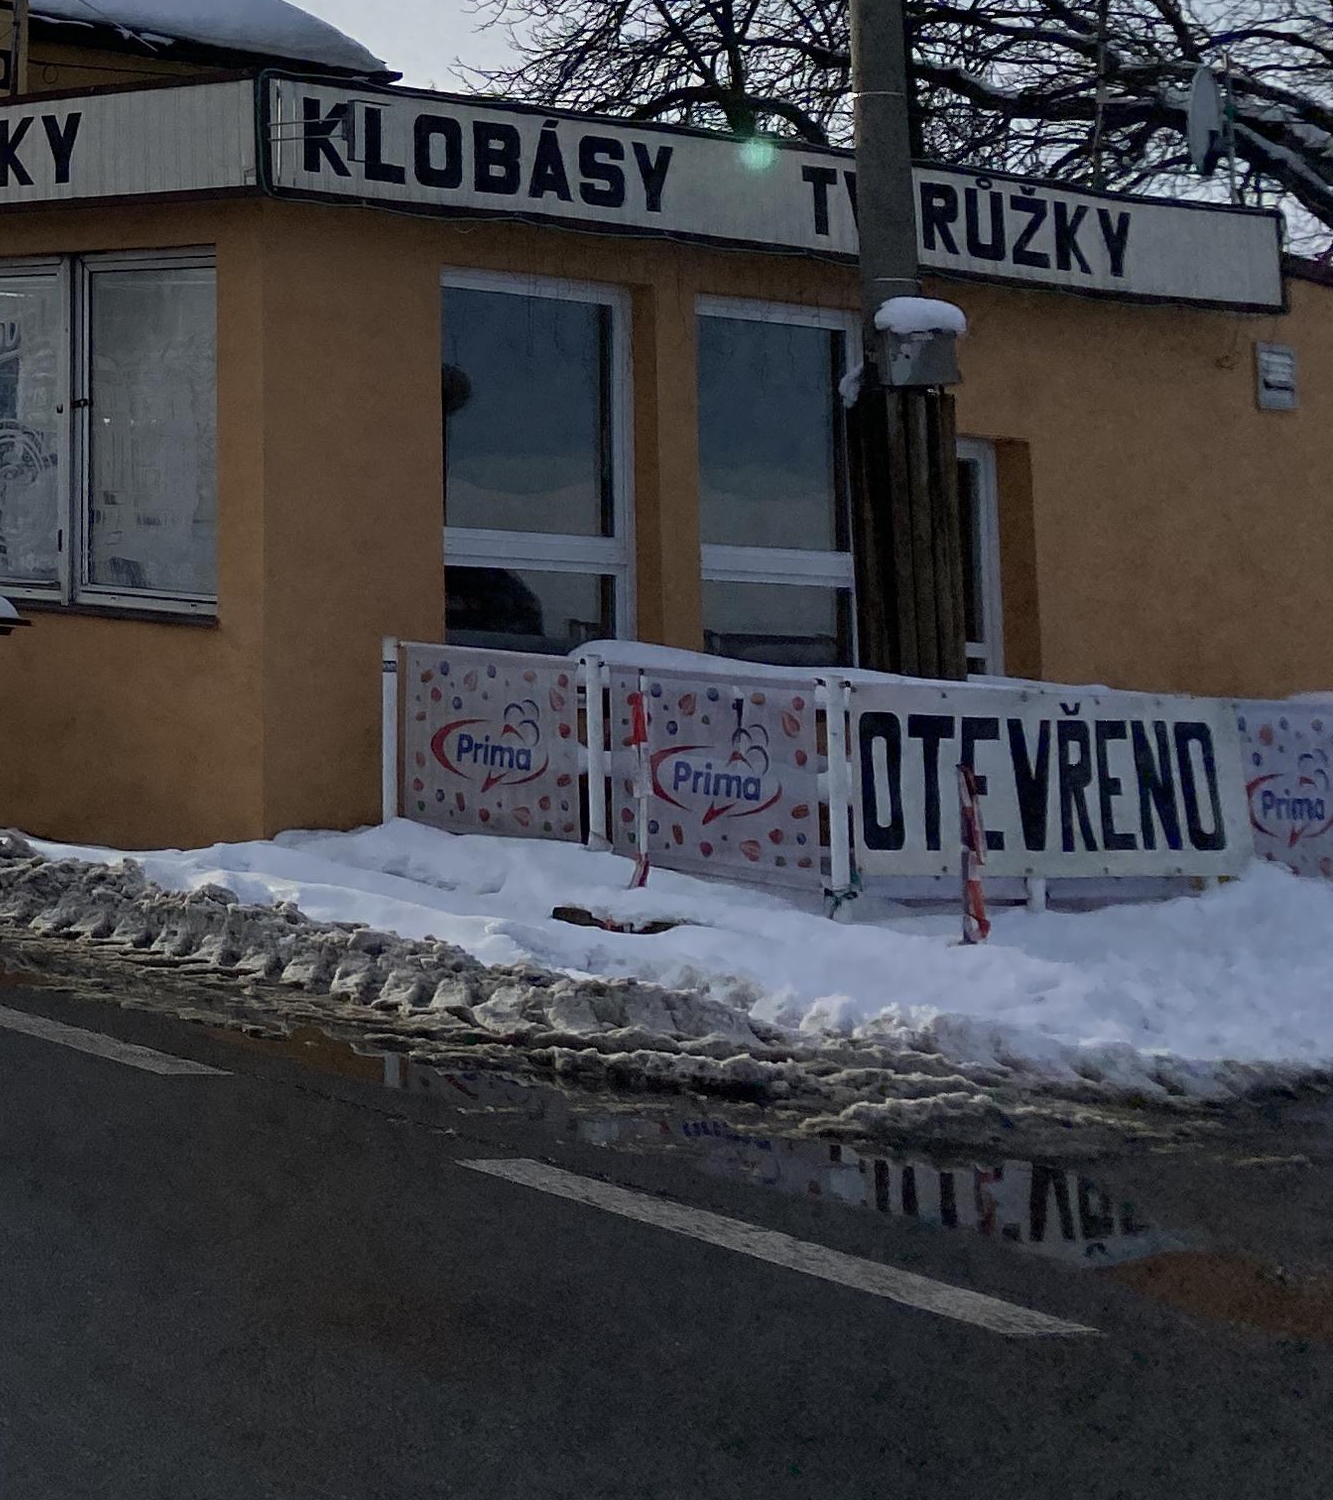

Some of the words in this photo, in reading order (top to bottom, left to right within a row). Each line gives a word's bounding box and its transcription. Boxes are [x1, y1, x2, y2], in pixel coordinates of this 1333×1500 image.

[302, 96, 674, 212] KLOBÁSY
[801, 164, 1131, 277] TRŮŽKY
[456, 733, 533, 773] Prima
[672, 760, 763, 802] Prima
[858, 702, 1227, 852] OTEVŘENO
[1261, 787, 1326, 821] Prima
